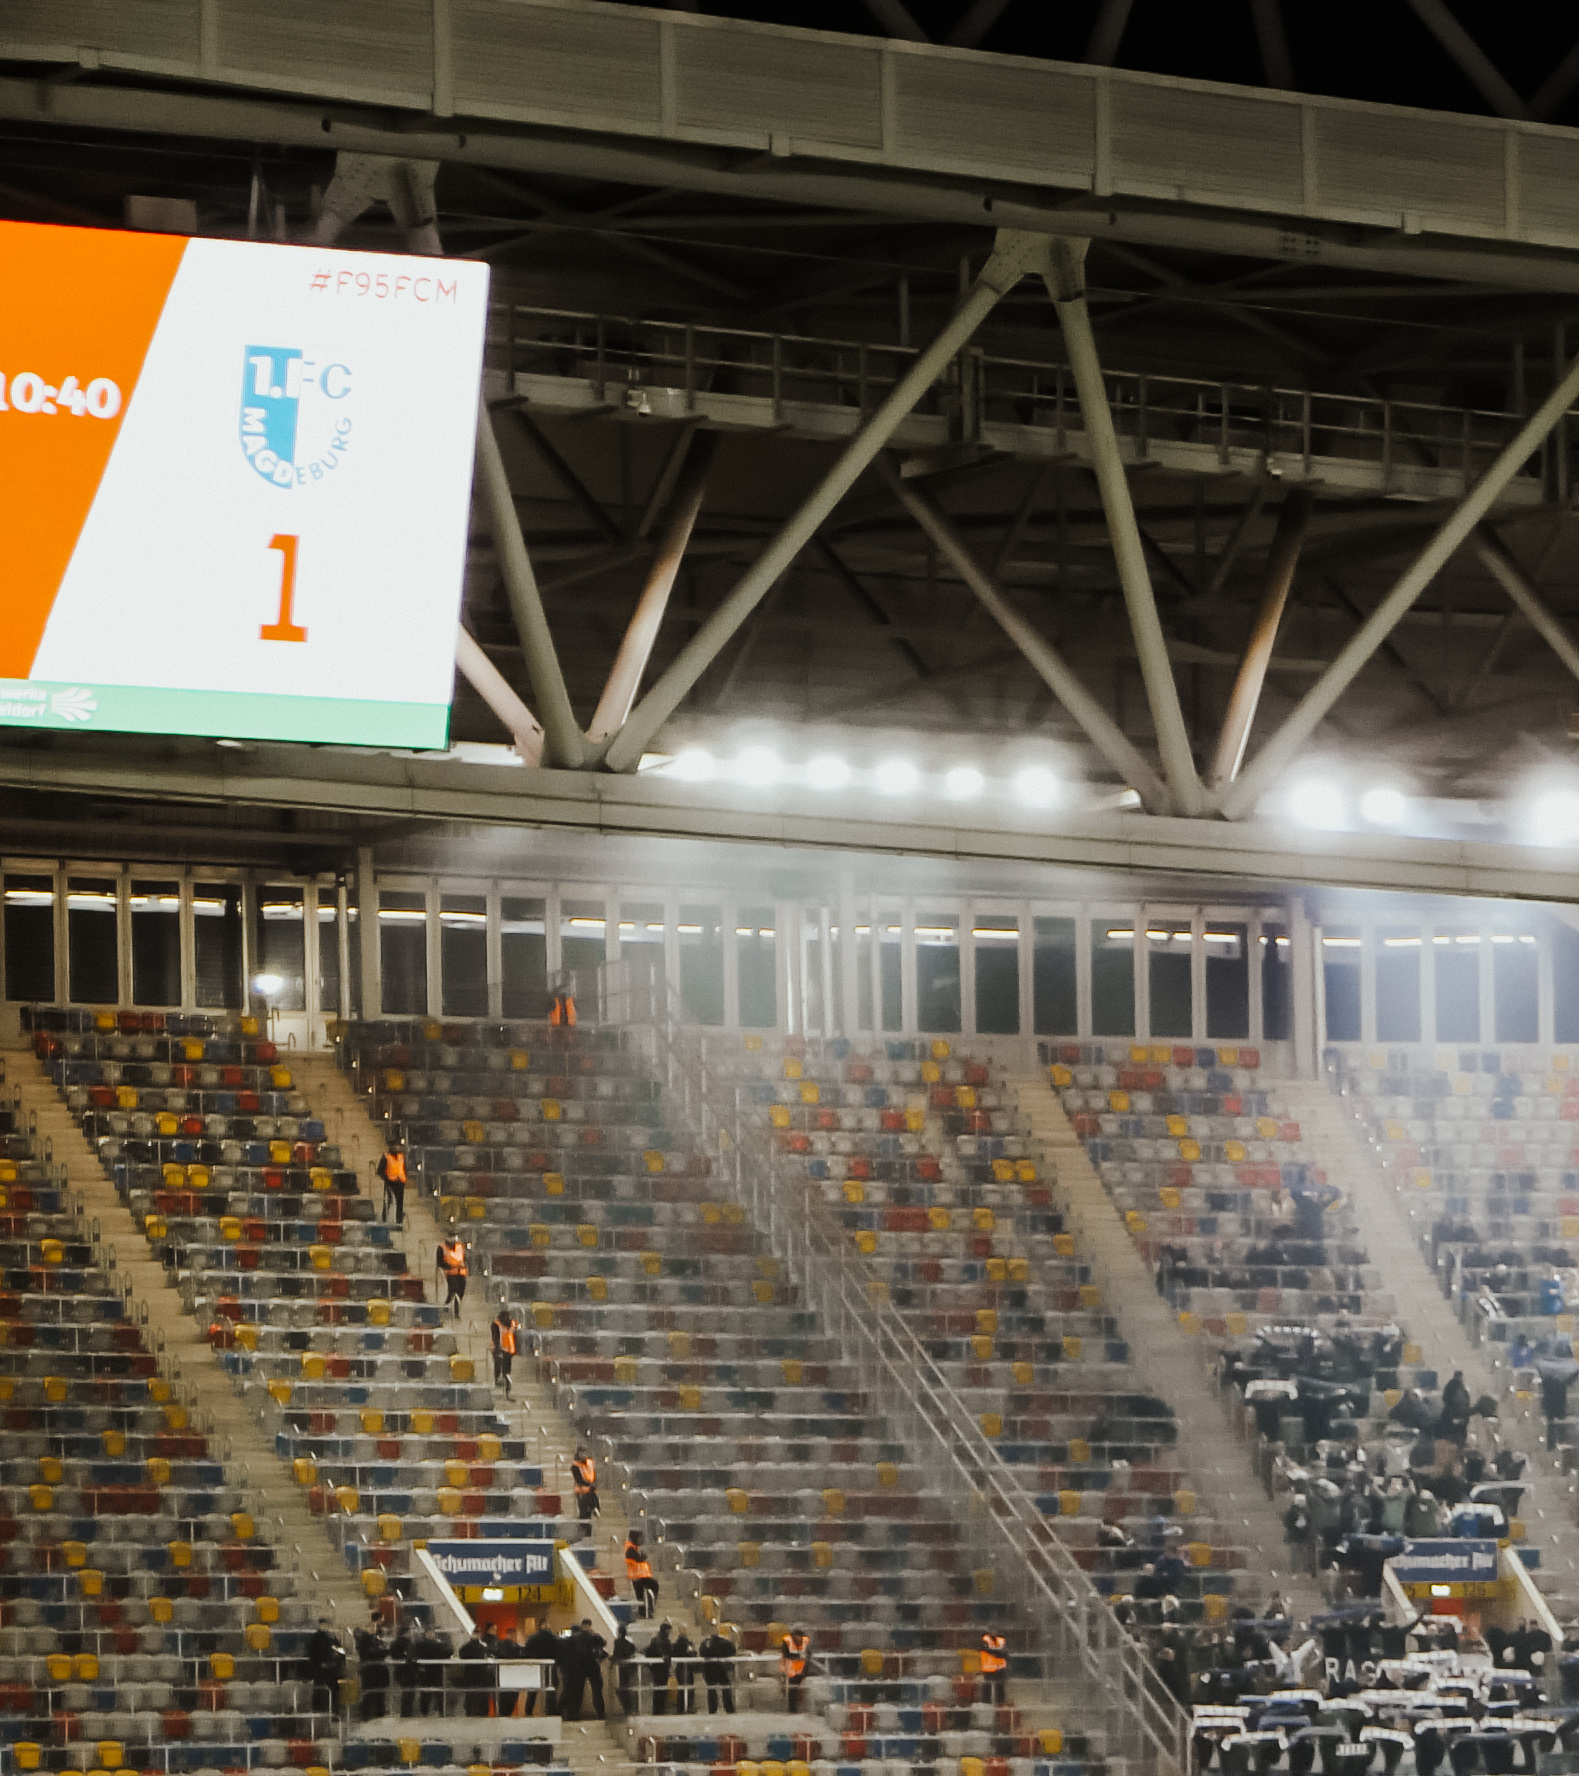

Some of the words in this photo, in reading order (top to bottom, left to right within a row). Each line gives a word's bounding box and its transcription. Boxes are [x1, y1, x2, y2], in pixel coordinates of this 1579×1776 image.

[309, 269, 459, 304] #F95FCM
[242, 406, 352, 486] MAGDEBURG
[258, 533, 308, 643] 1
